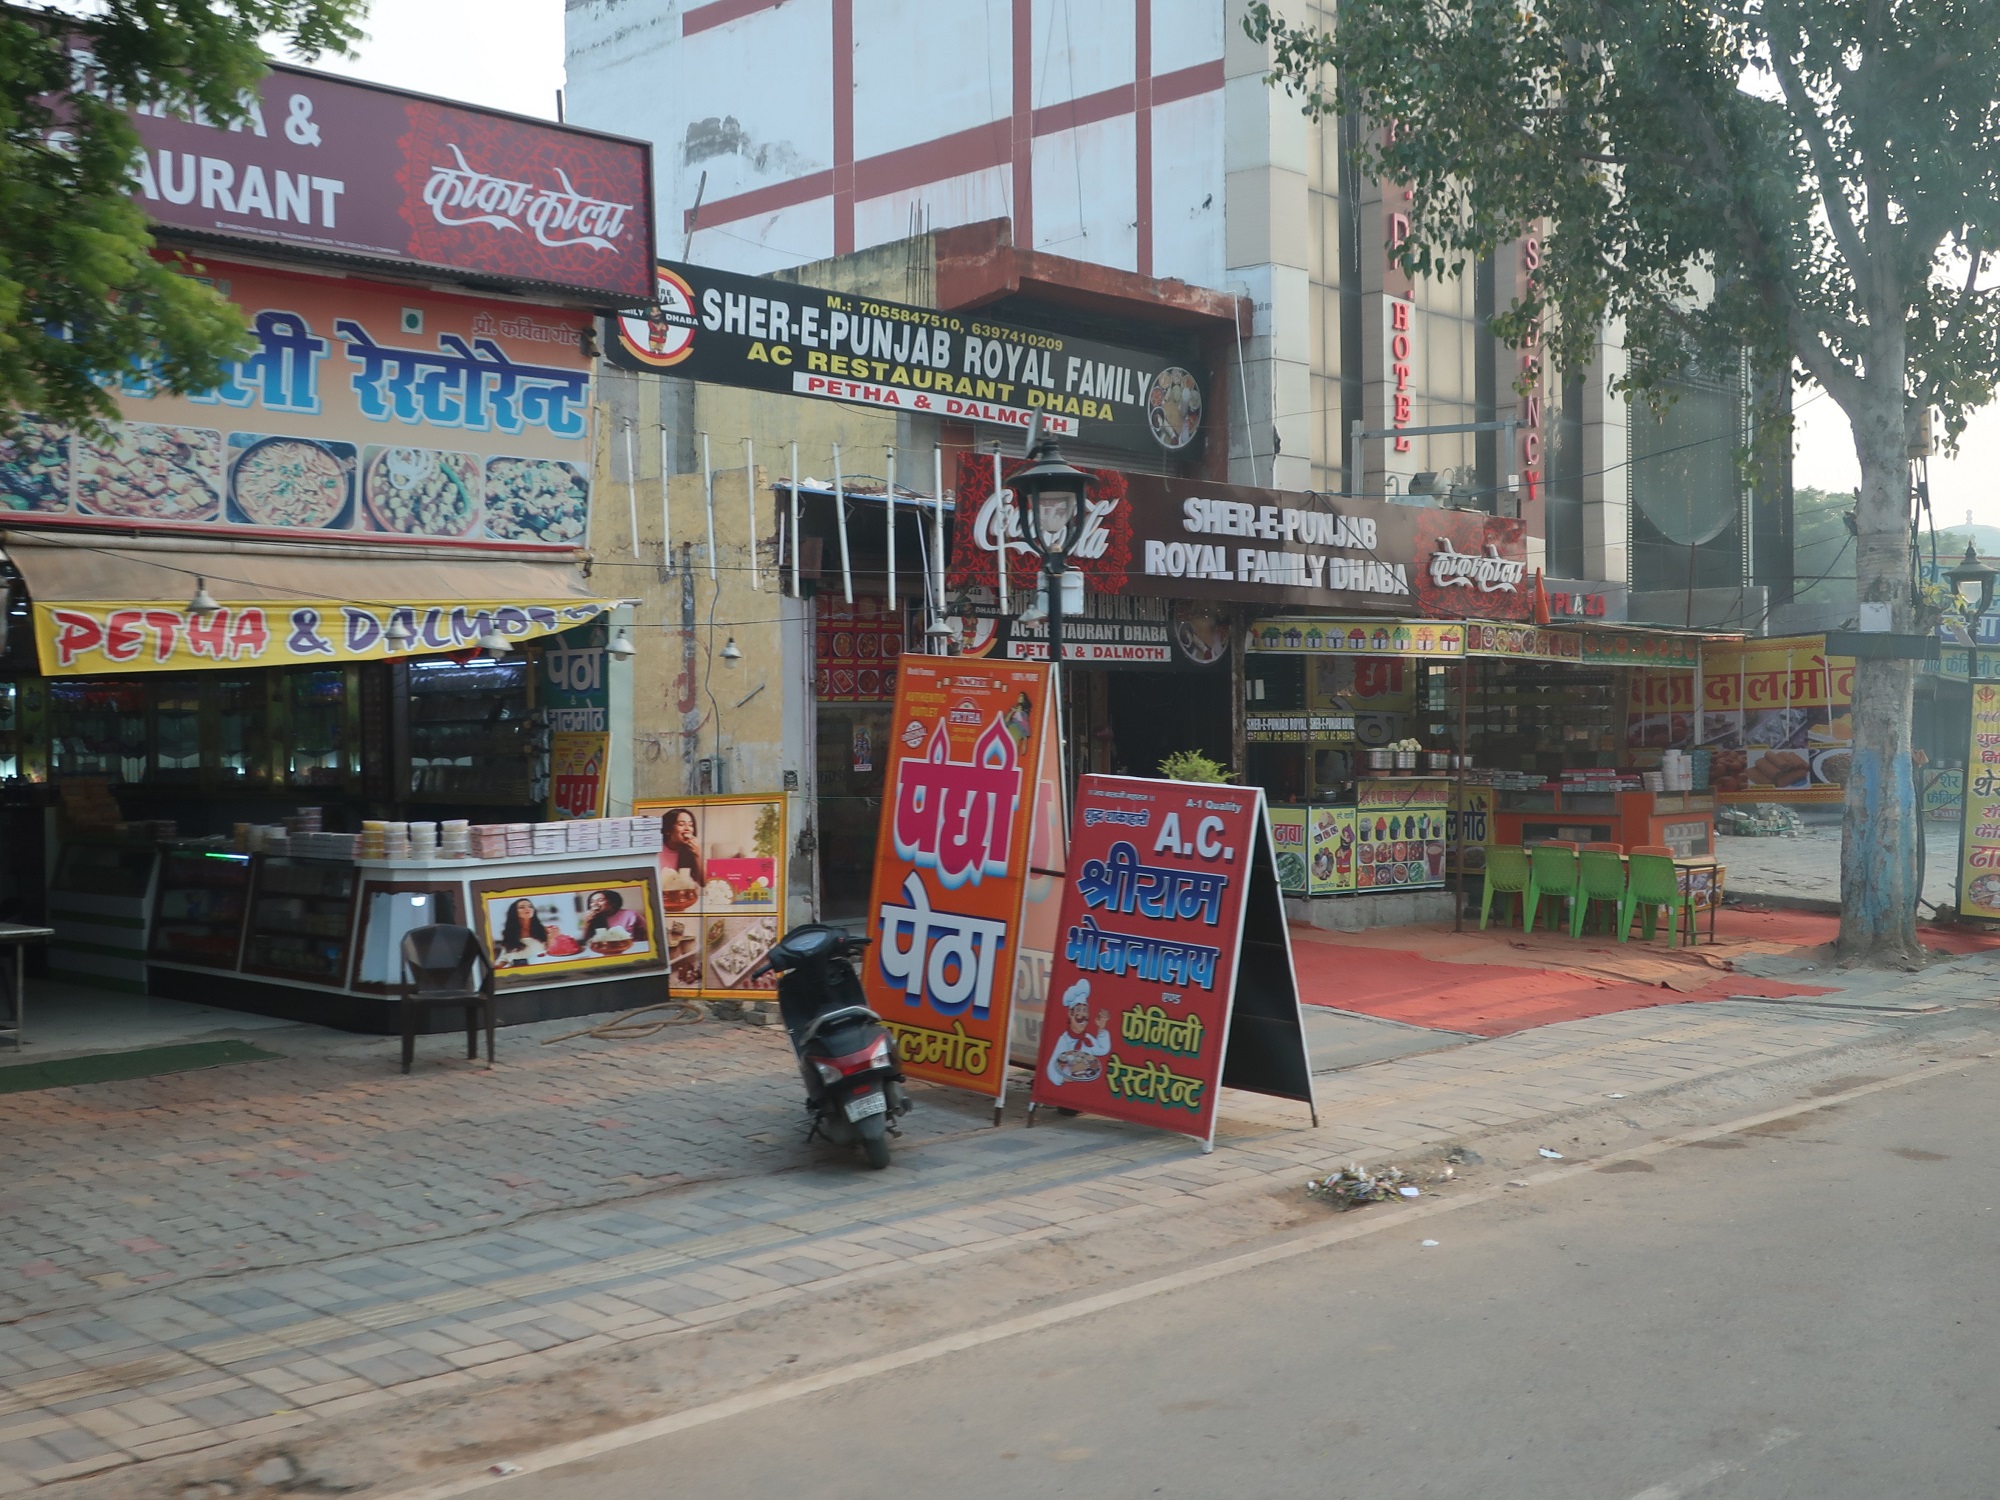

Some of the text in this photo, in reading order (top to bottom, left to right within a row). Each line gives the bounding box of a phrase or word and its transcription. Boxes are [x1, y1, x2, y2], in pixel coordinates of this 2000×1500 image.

[284, 93, 322, 148] &
[423, 143, 634, 254] कोका-कोला
[666, 314, 699, 326] DHABA
[702, 288, 1152, 407] SHER-E-PUNJAB ROYAL FAMILY
[971, 322, 1064, 351] 6397410209
[747, 341, 1114, 421] AC RESTAURANT DHABA
[808, 377, 900, 405] PETHA
[913, 395, 931, 410] &
[1391, 302, 1412, 453] HOTEL
[1182, 497, 1378, 551] SHER-E-PUNJAB
[1144, 539, 1410, 595] ROYAL FAMILY DHABA
[1034, 622, 1121, 640] RETAURANT
[1123, 625, 1168, 641] DHABA
[1553, 592, 1606, 616] PLAZA
[54, 608, 269, 667] PETHA
[287, 606, 335, 655] &
[546, 633, 604, 690] पेठा
[1015, 643, 1165, 659] PETA & DALMOTH
[1186, 799, 1243, 814] A-1 Quality
[1153, 812, 1235, 861] A.C.
[1076, 841, 1229, 925] श्रीराम
[880, 870, 1007, 1014] पेठा
[1065, 915, 1220, 990] भोजनालय
[878, 1019, 992, 1075] ालमोठ
[1121, 1004, 1204, 1054] फैमिली
